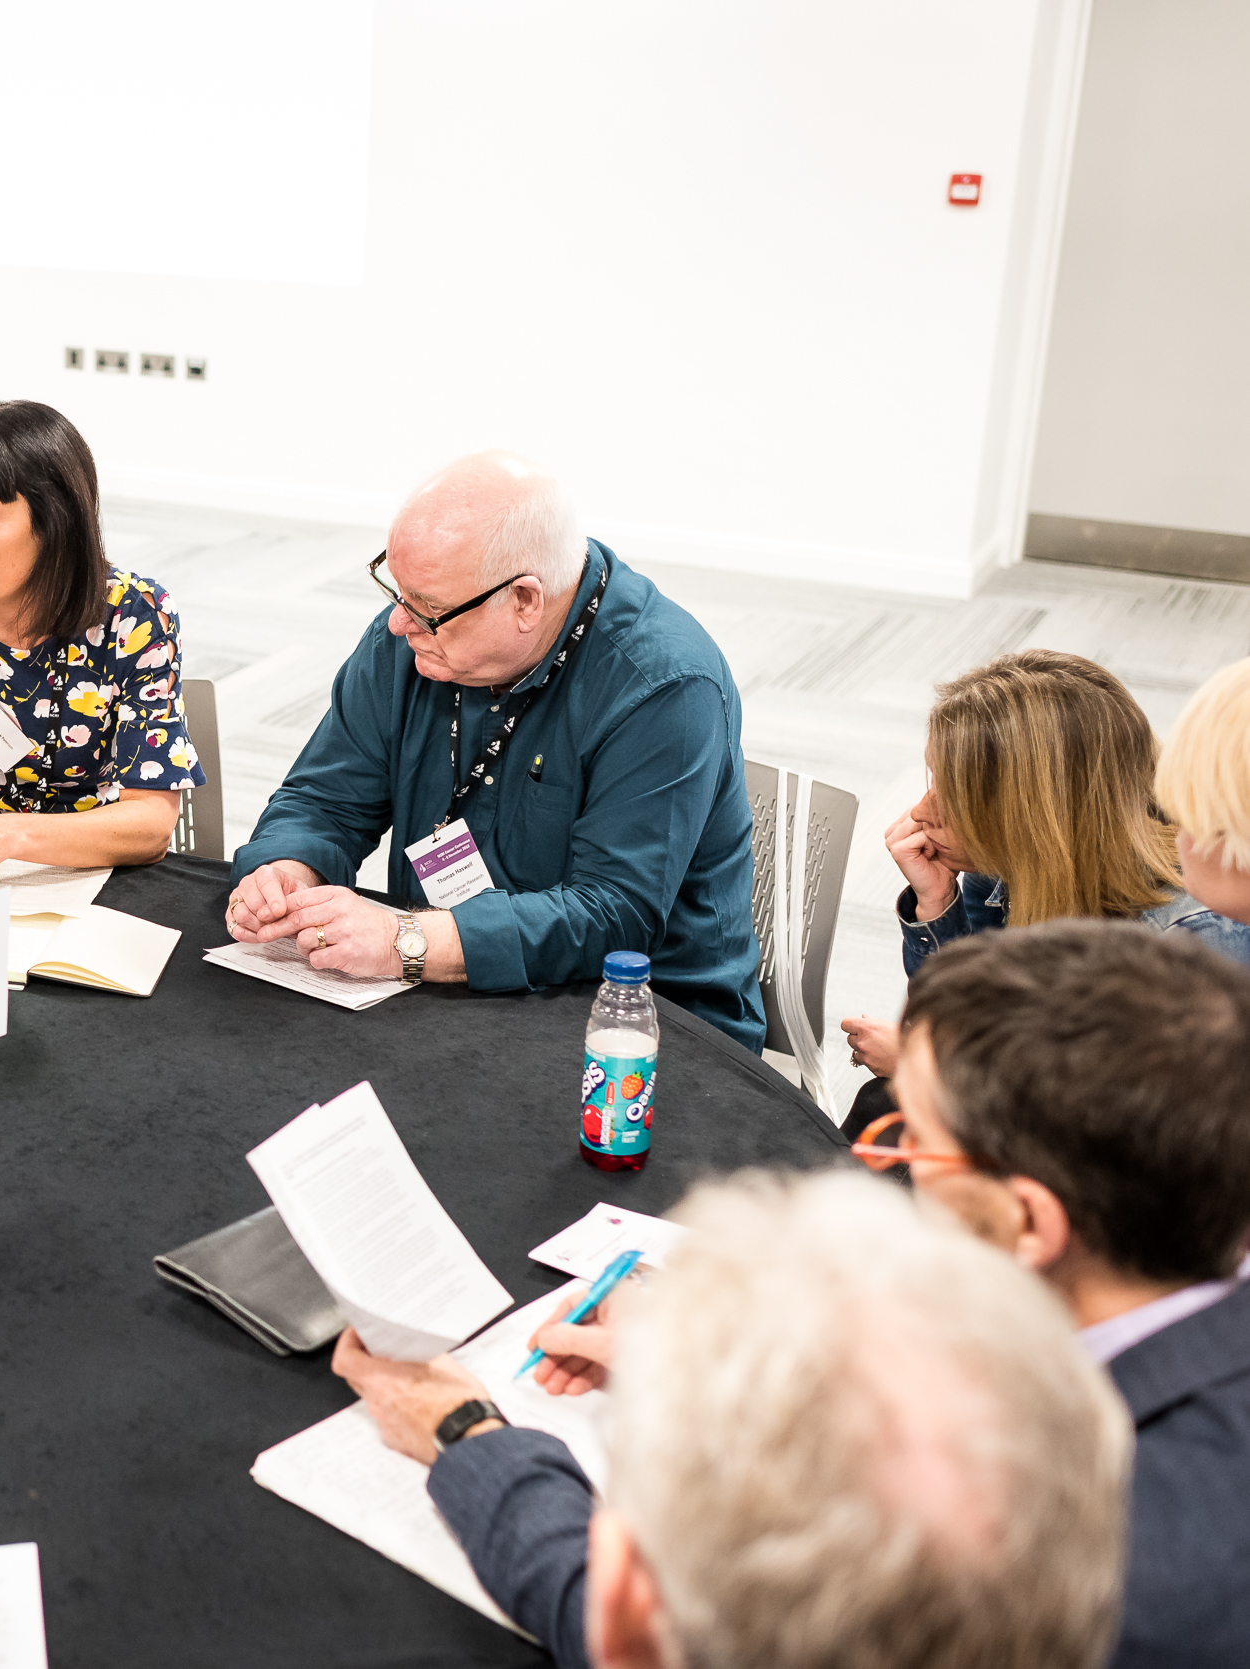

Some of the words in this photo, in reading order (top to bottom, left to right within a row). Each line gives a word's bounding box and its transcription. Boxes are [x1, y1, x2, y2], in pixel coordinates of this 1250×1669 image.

[437, 873, 455, 884] Thomas
[455, 862, 473, 874] Haswell
[439, 889, 454, 900] National
[454, 883, 466, 892] Cancer
[466, 874, 484, 885] Research
[456, 888, 471, 898] Institute
